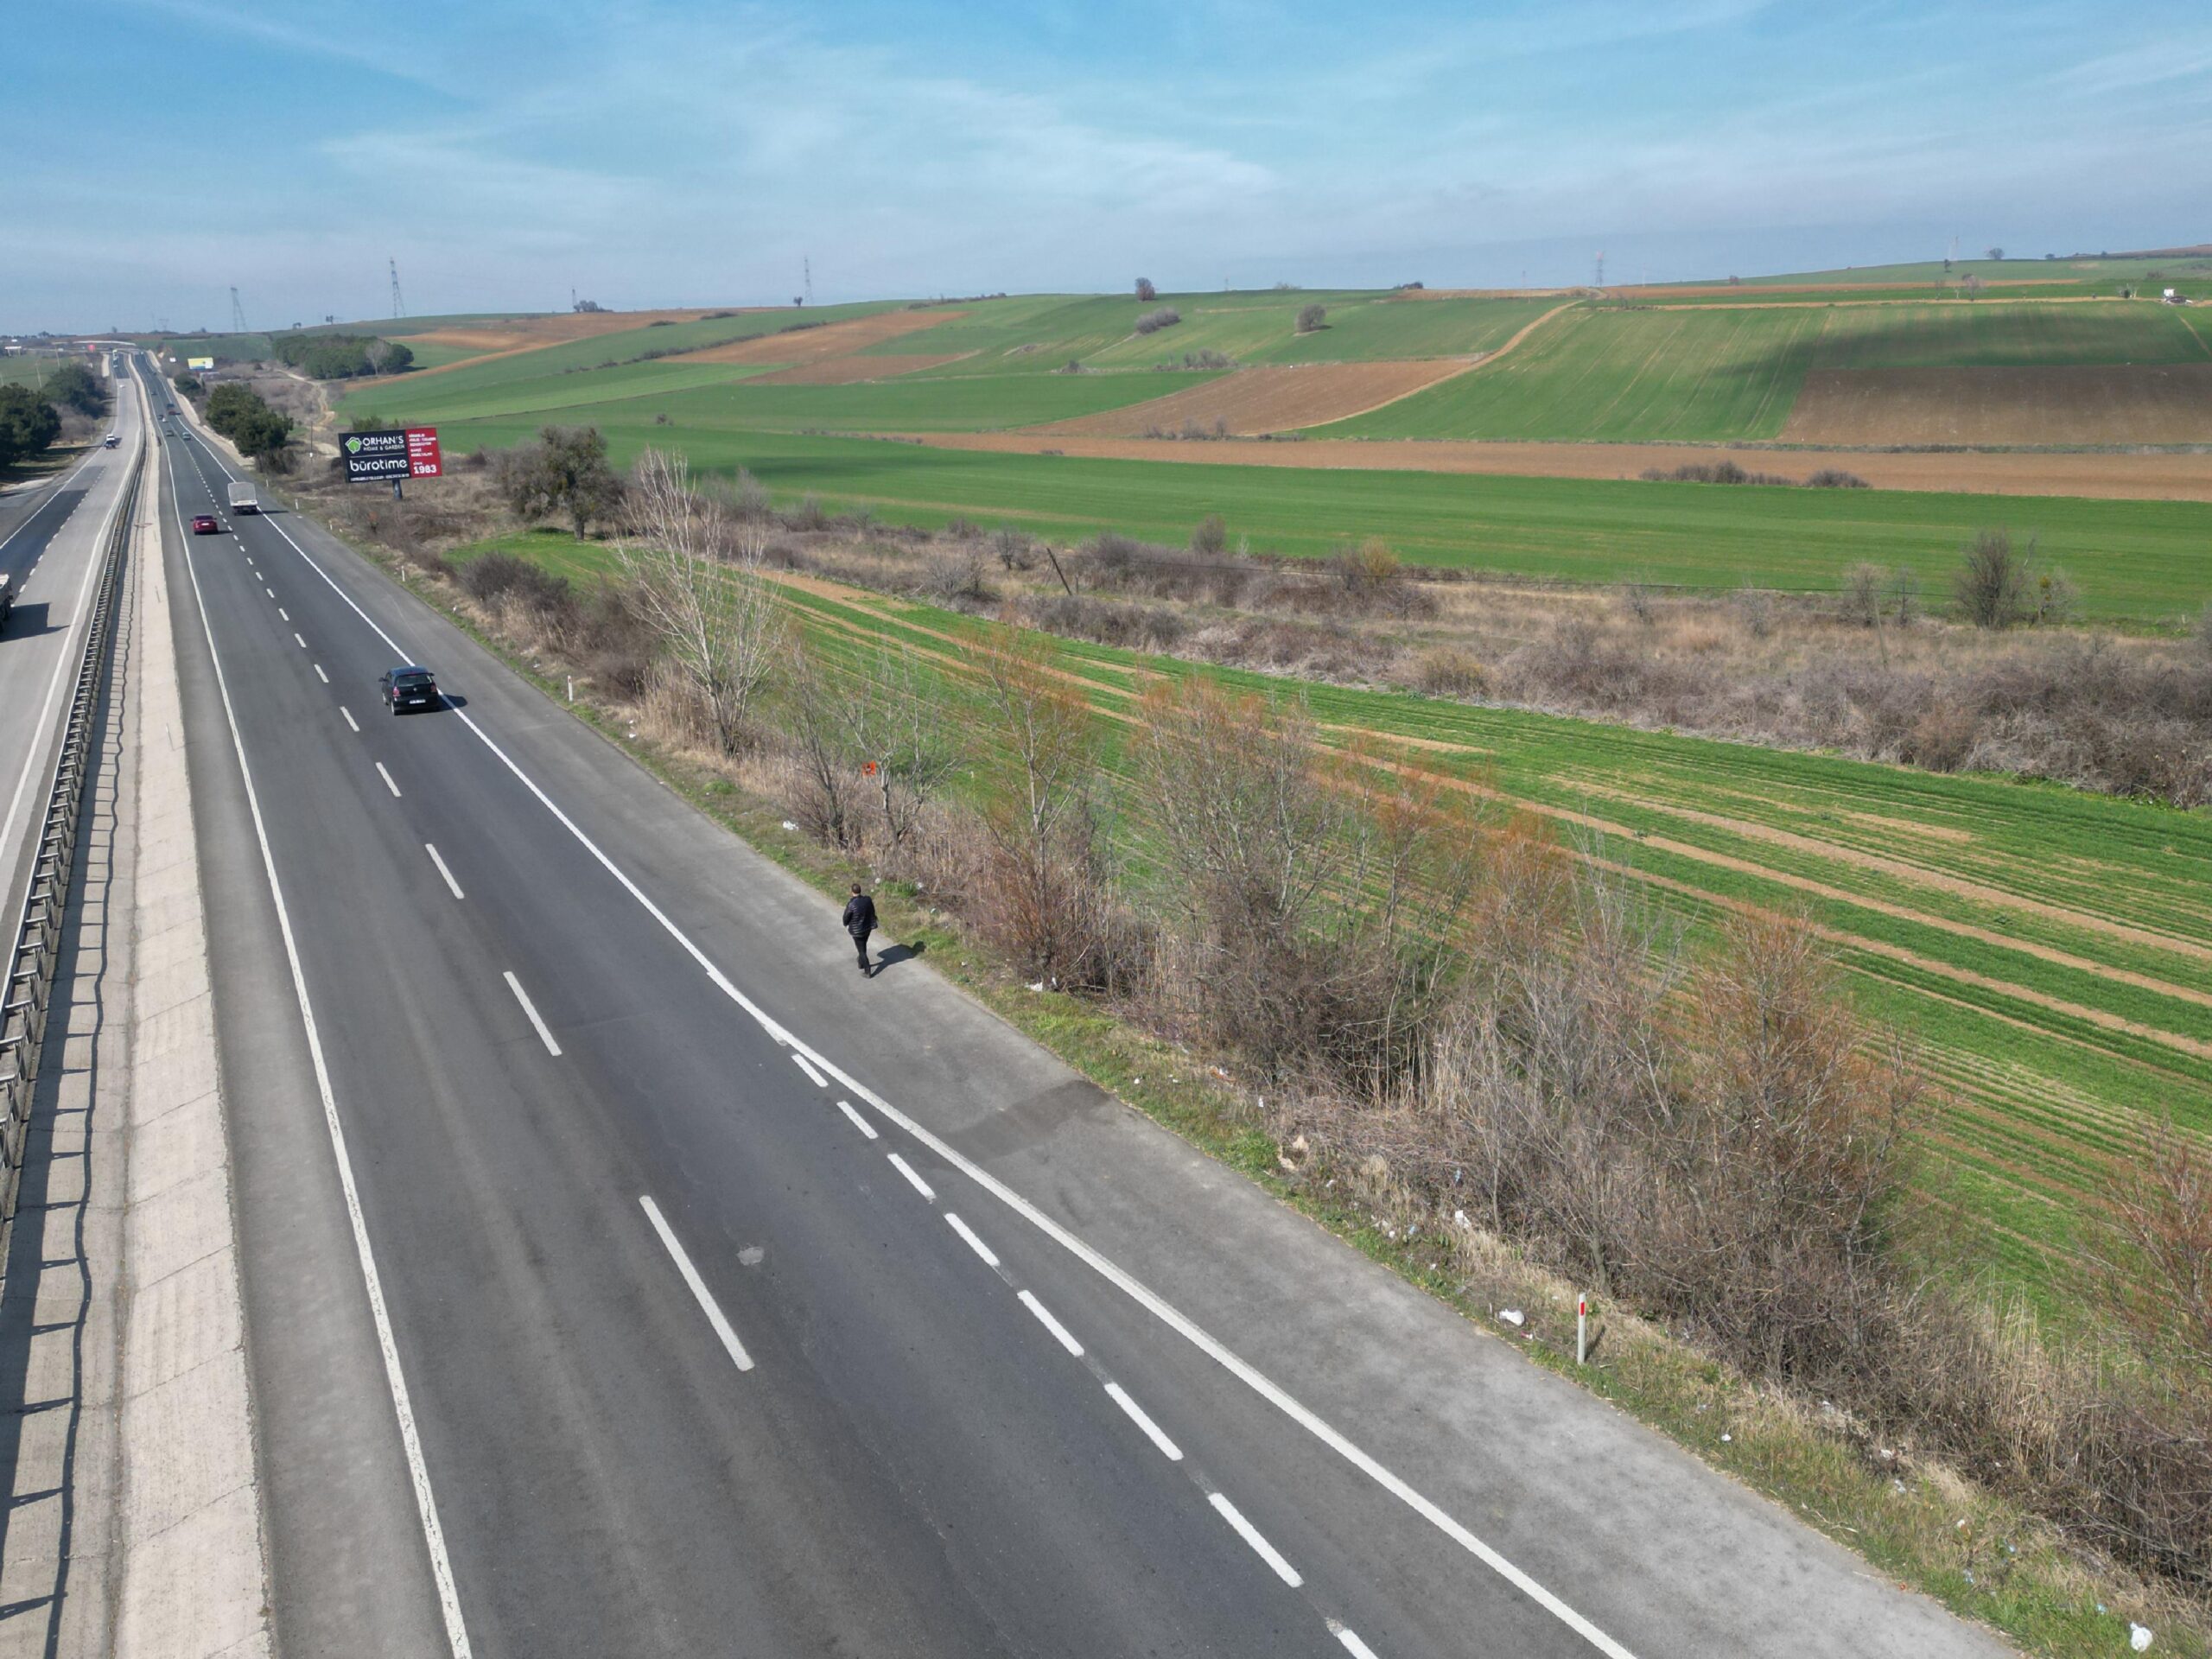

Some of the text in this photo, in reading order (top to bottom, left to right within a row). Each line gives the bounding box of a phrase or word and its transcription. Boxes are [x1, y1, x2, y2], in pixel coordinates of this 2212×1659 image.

[362, 435, 404, 447] ORHAN'S
[349, 459, 408, 472] bürotime
[413, 464, 437, 474] 1983
